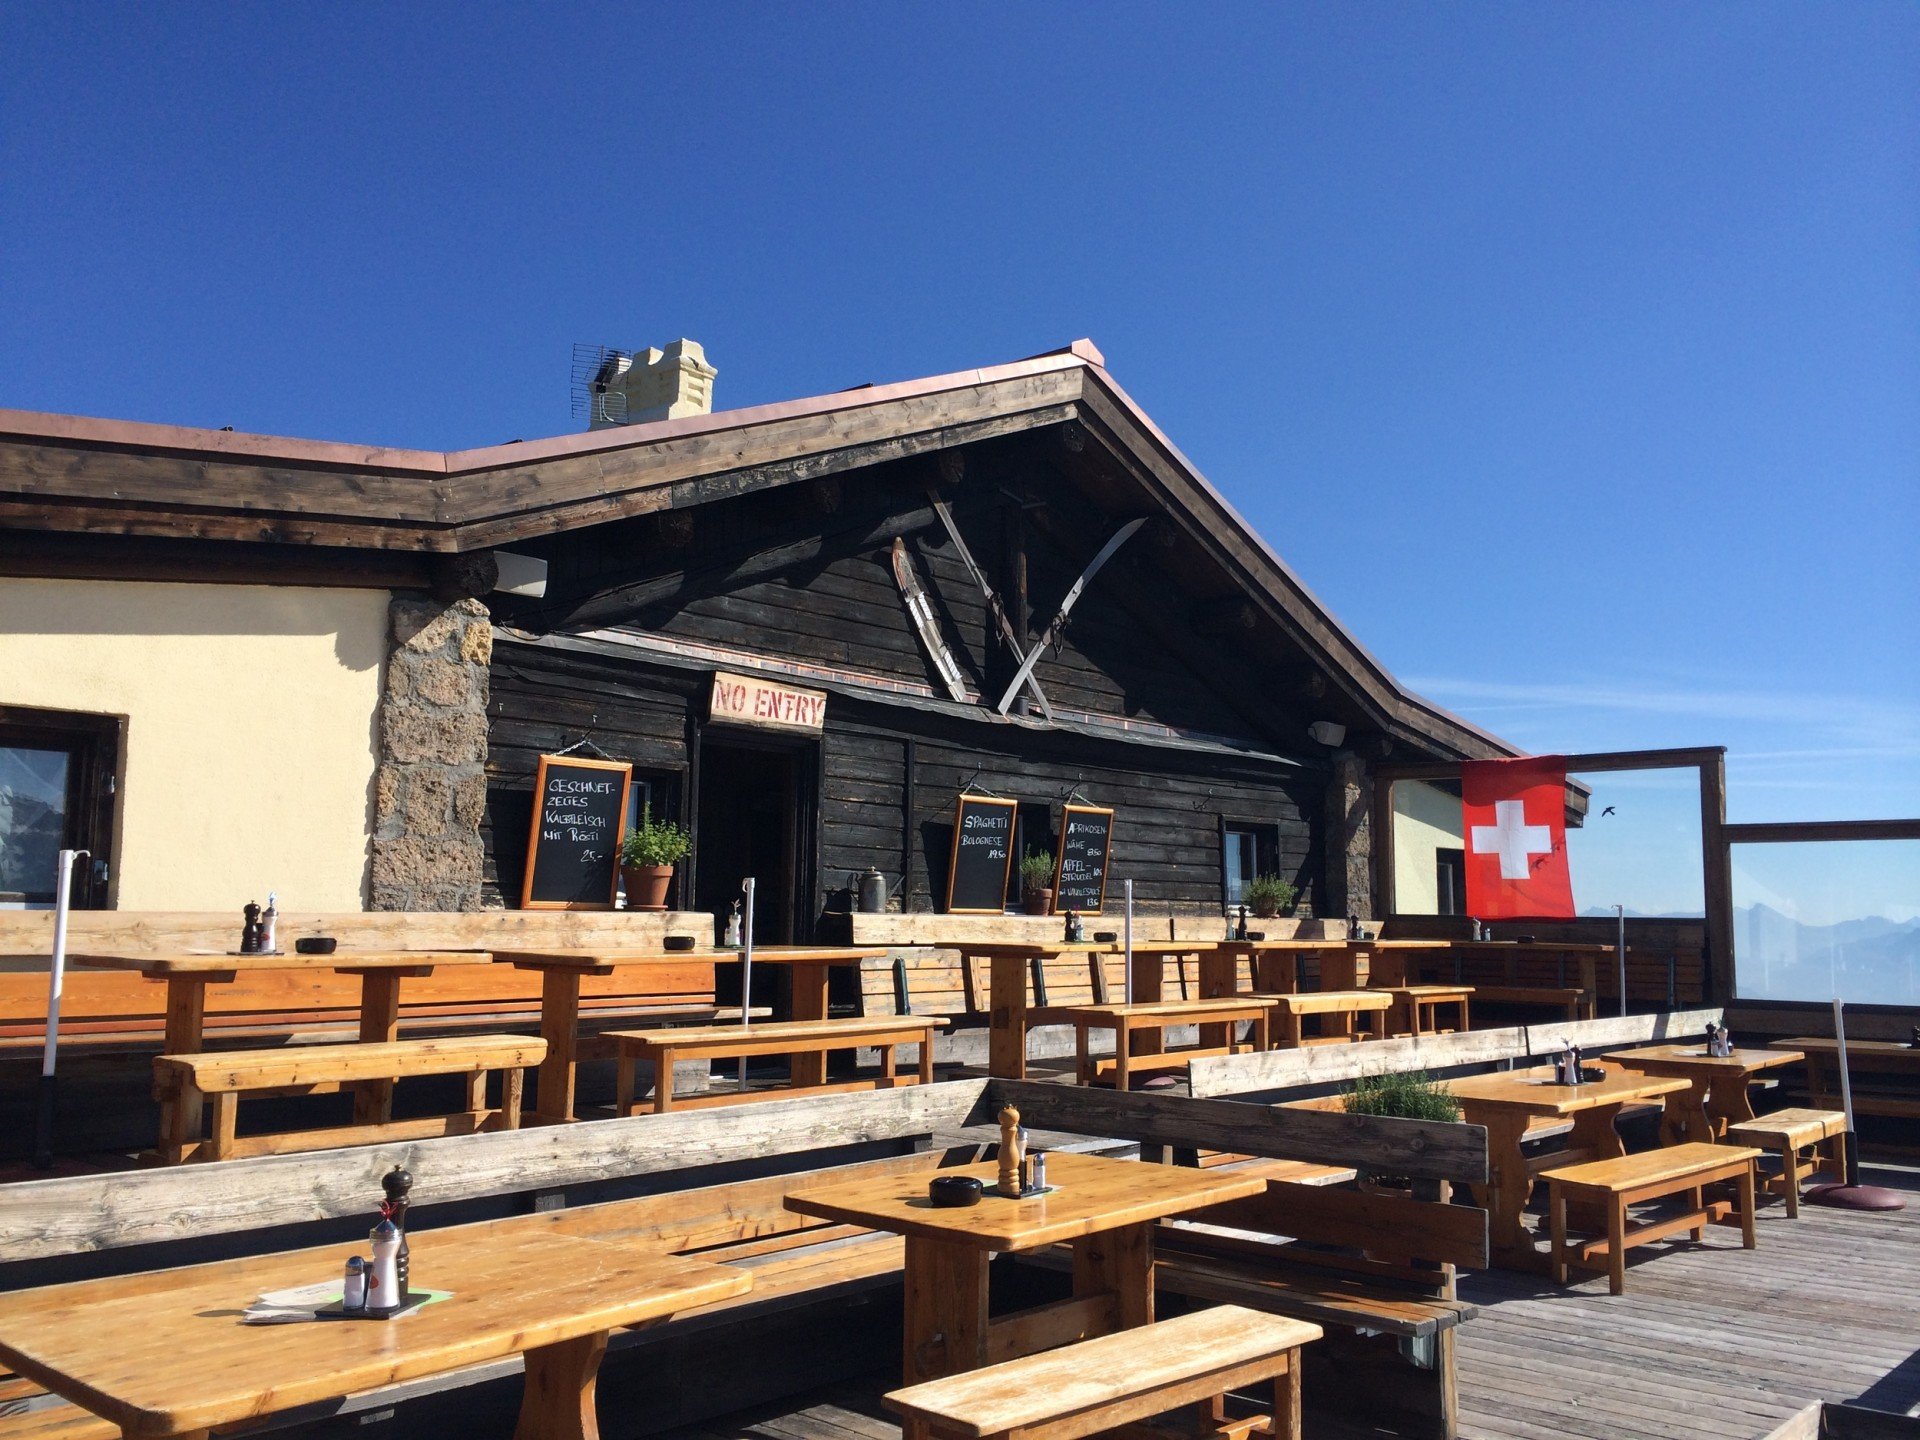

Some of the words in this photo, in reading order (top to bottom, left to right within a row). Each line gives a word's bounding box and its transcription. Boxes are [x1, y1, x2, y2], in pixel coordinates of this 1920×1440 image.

[715, 680, 746, 712] NO
[754, 688, 824, 725] ENTRY
[548, 778, 616, 795] GESCHNET-
[960, 834, 1004, 847] BOLOGNESE
